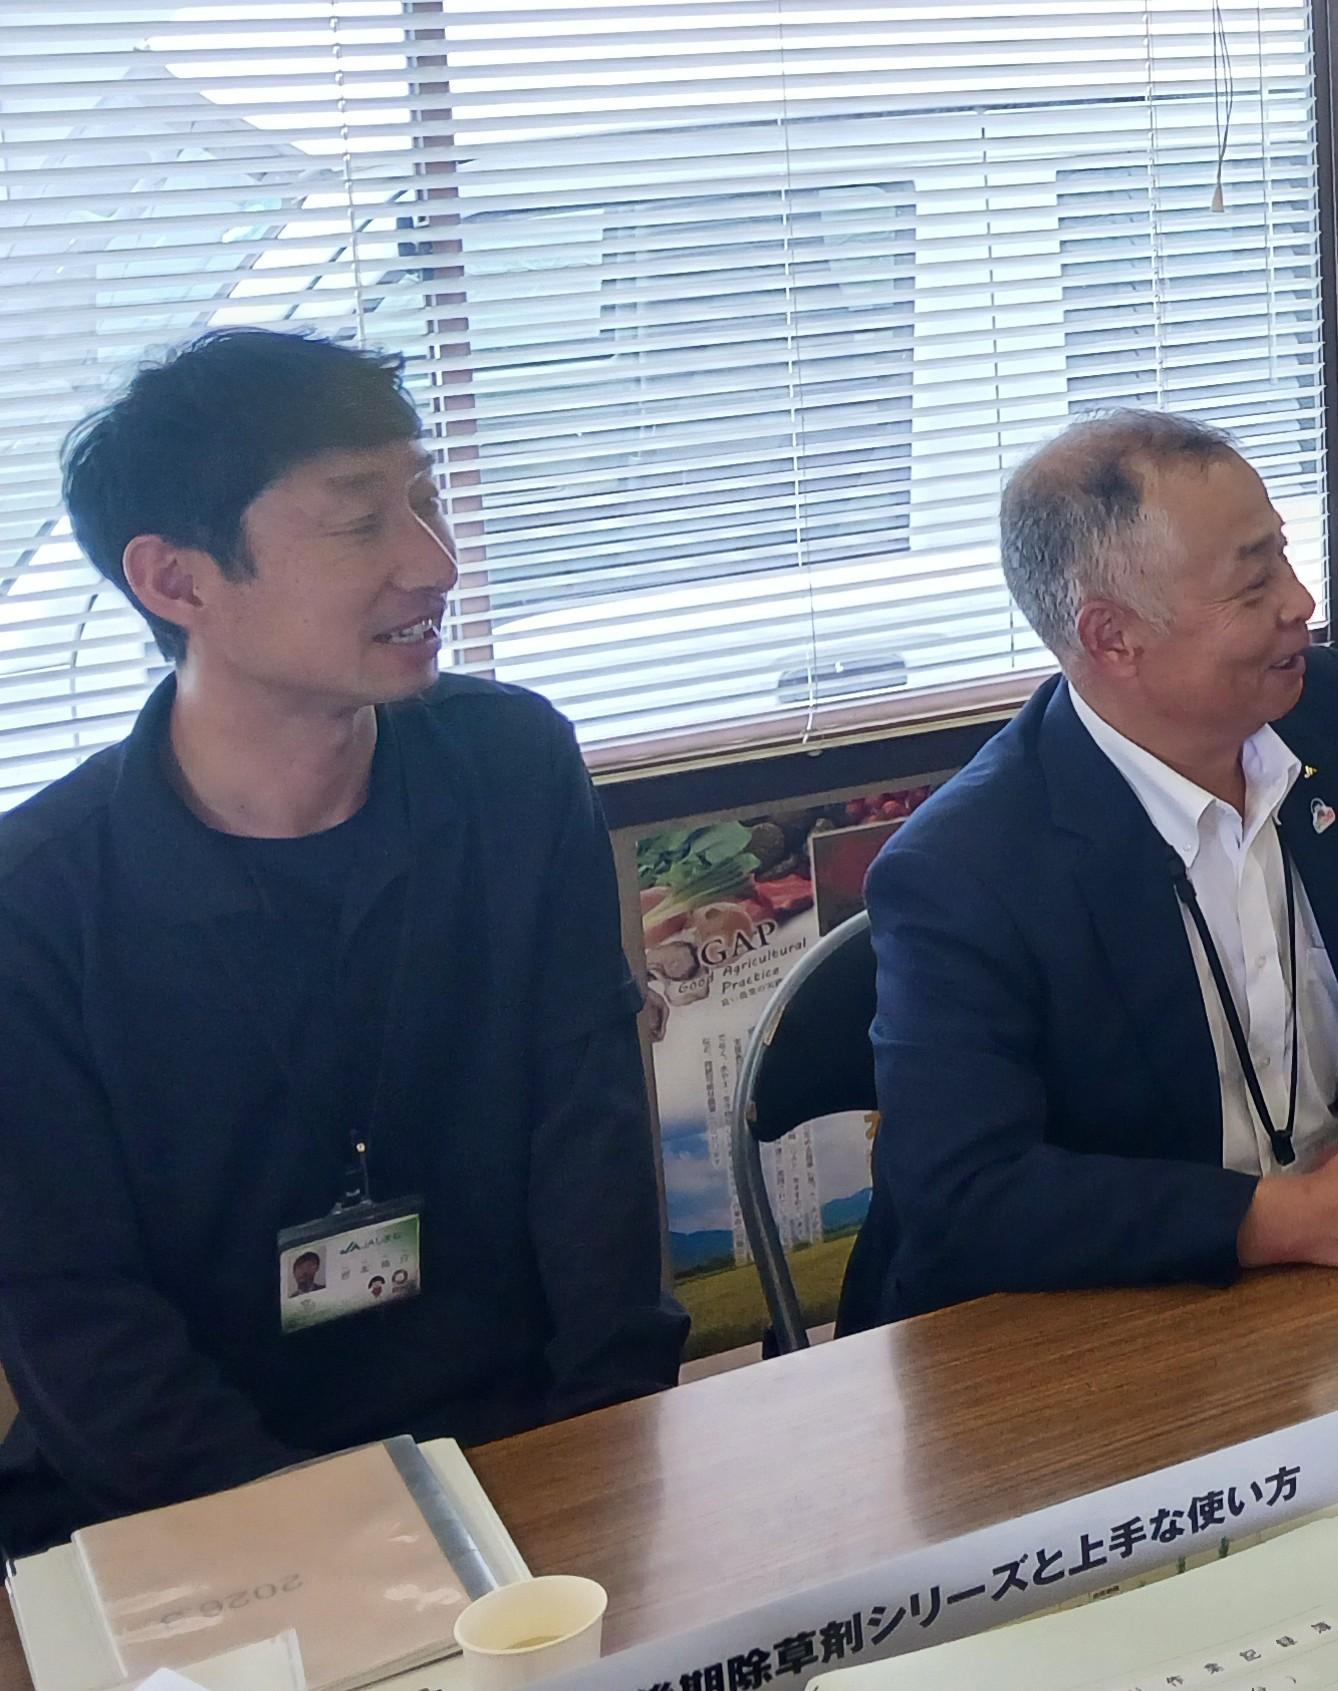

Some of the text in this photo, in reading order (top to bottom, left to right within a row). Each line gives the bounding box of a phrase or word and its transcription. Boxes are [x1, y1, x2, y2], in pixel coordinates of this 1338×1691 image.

[678, 937, 807, 994] Good Agricultural
[701, 921, 776, 966] GAP
[722, 966, 780, 994] Practice
[637, 1464, 1301, 1691] 期除草剤シリーズと上手な使い方
